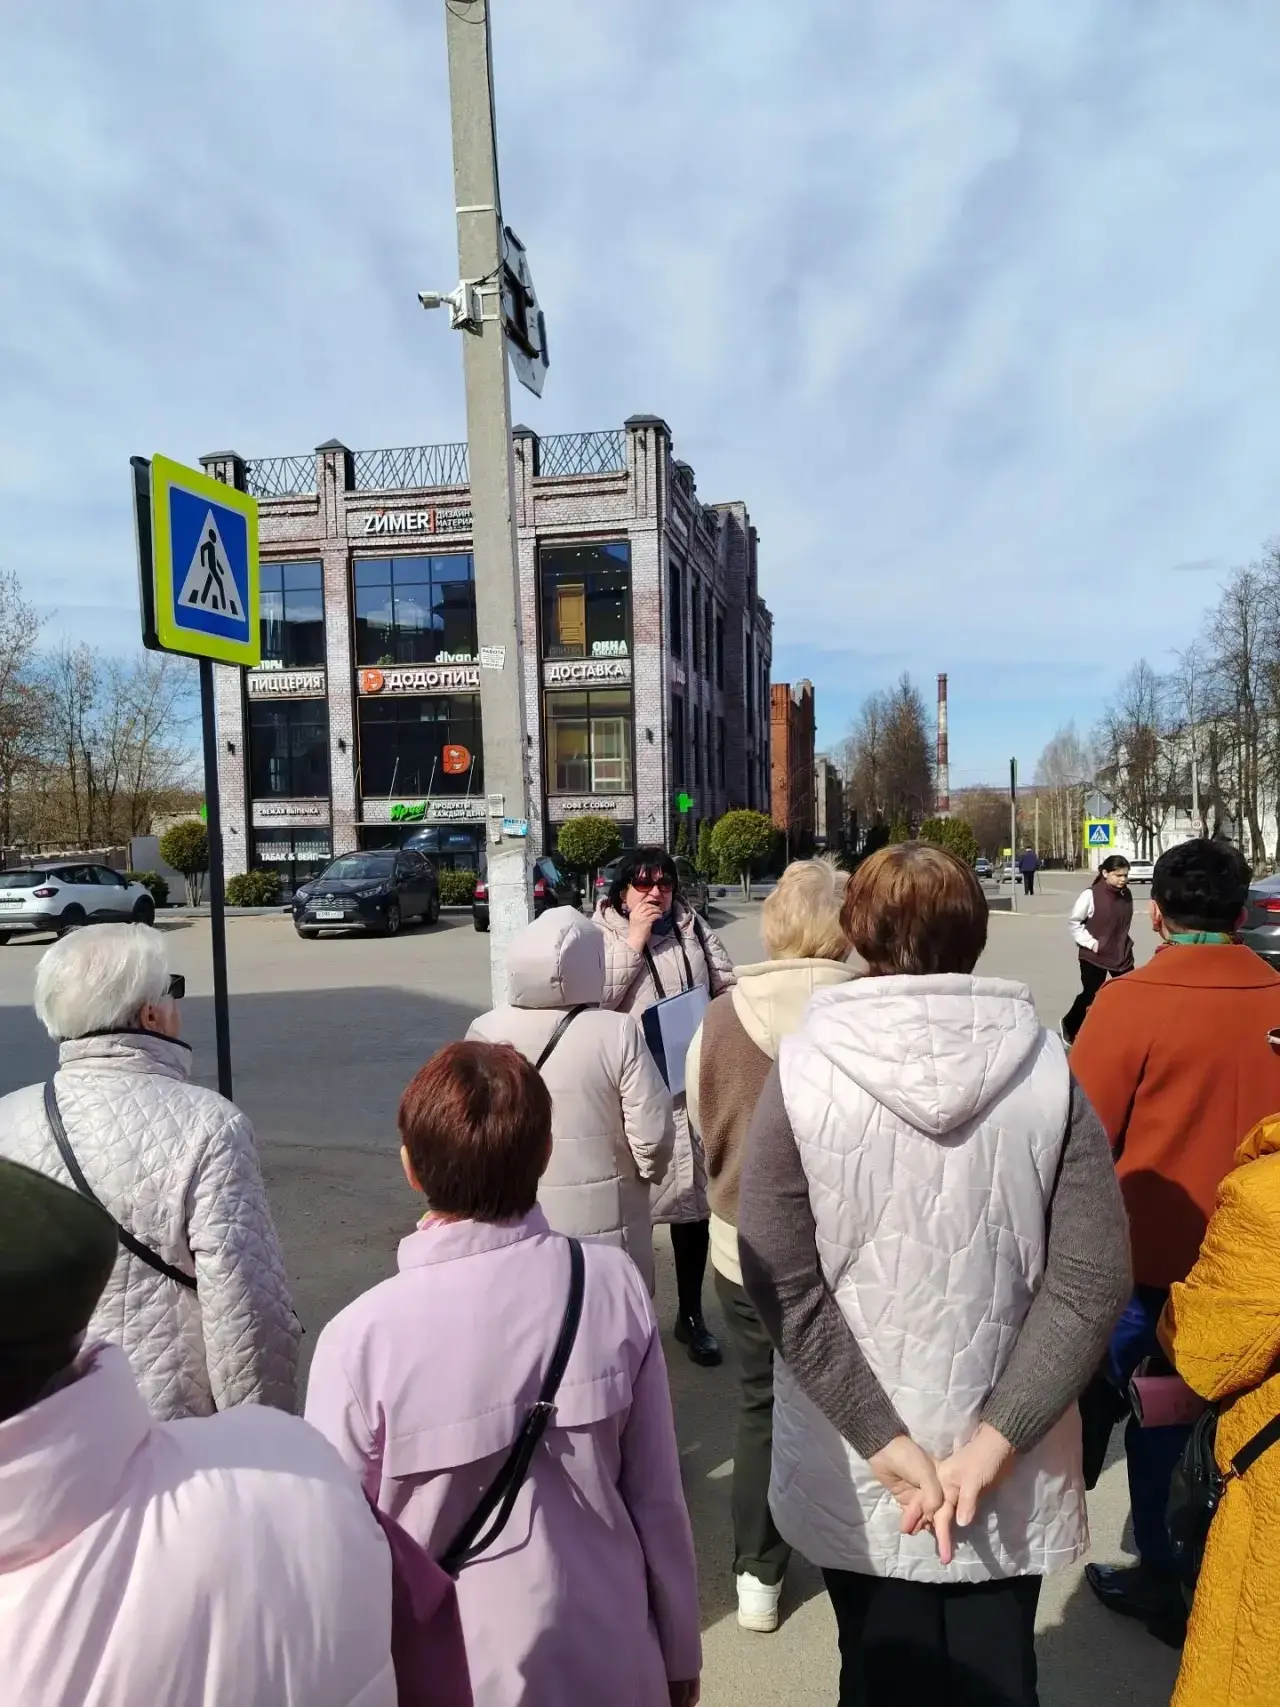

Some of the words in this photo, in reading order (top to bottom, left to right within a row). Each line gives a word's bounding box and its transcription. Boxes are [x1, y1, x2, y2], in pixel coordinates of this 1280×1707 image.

[436, 517, 474, 527] МАТЕРИА
[390, 671, 439, 689] ДОДО
[440, 670, 479, 686] ПИЦ
[550, 664, 624, 680] ДОСТАВКА
[250, 676, 321, 692] ПИЦЦЕРИЯ
[261, 853, 287, 861] ТАБАК
[287, 853, 296, 861] &
